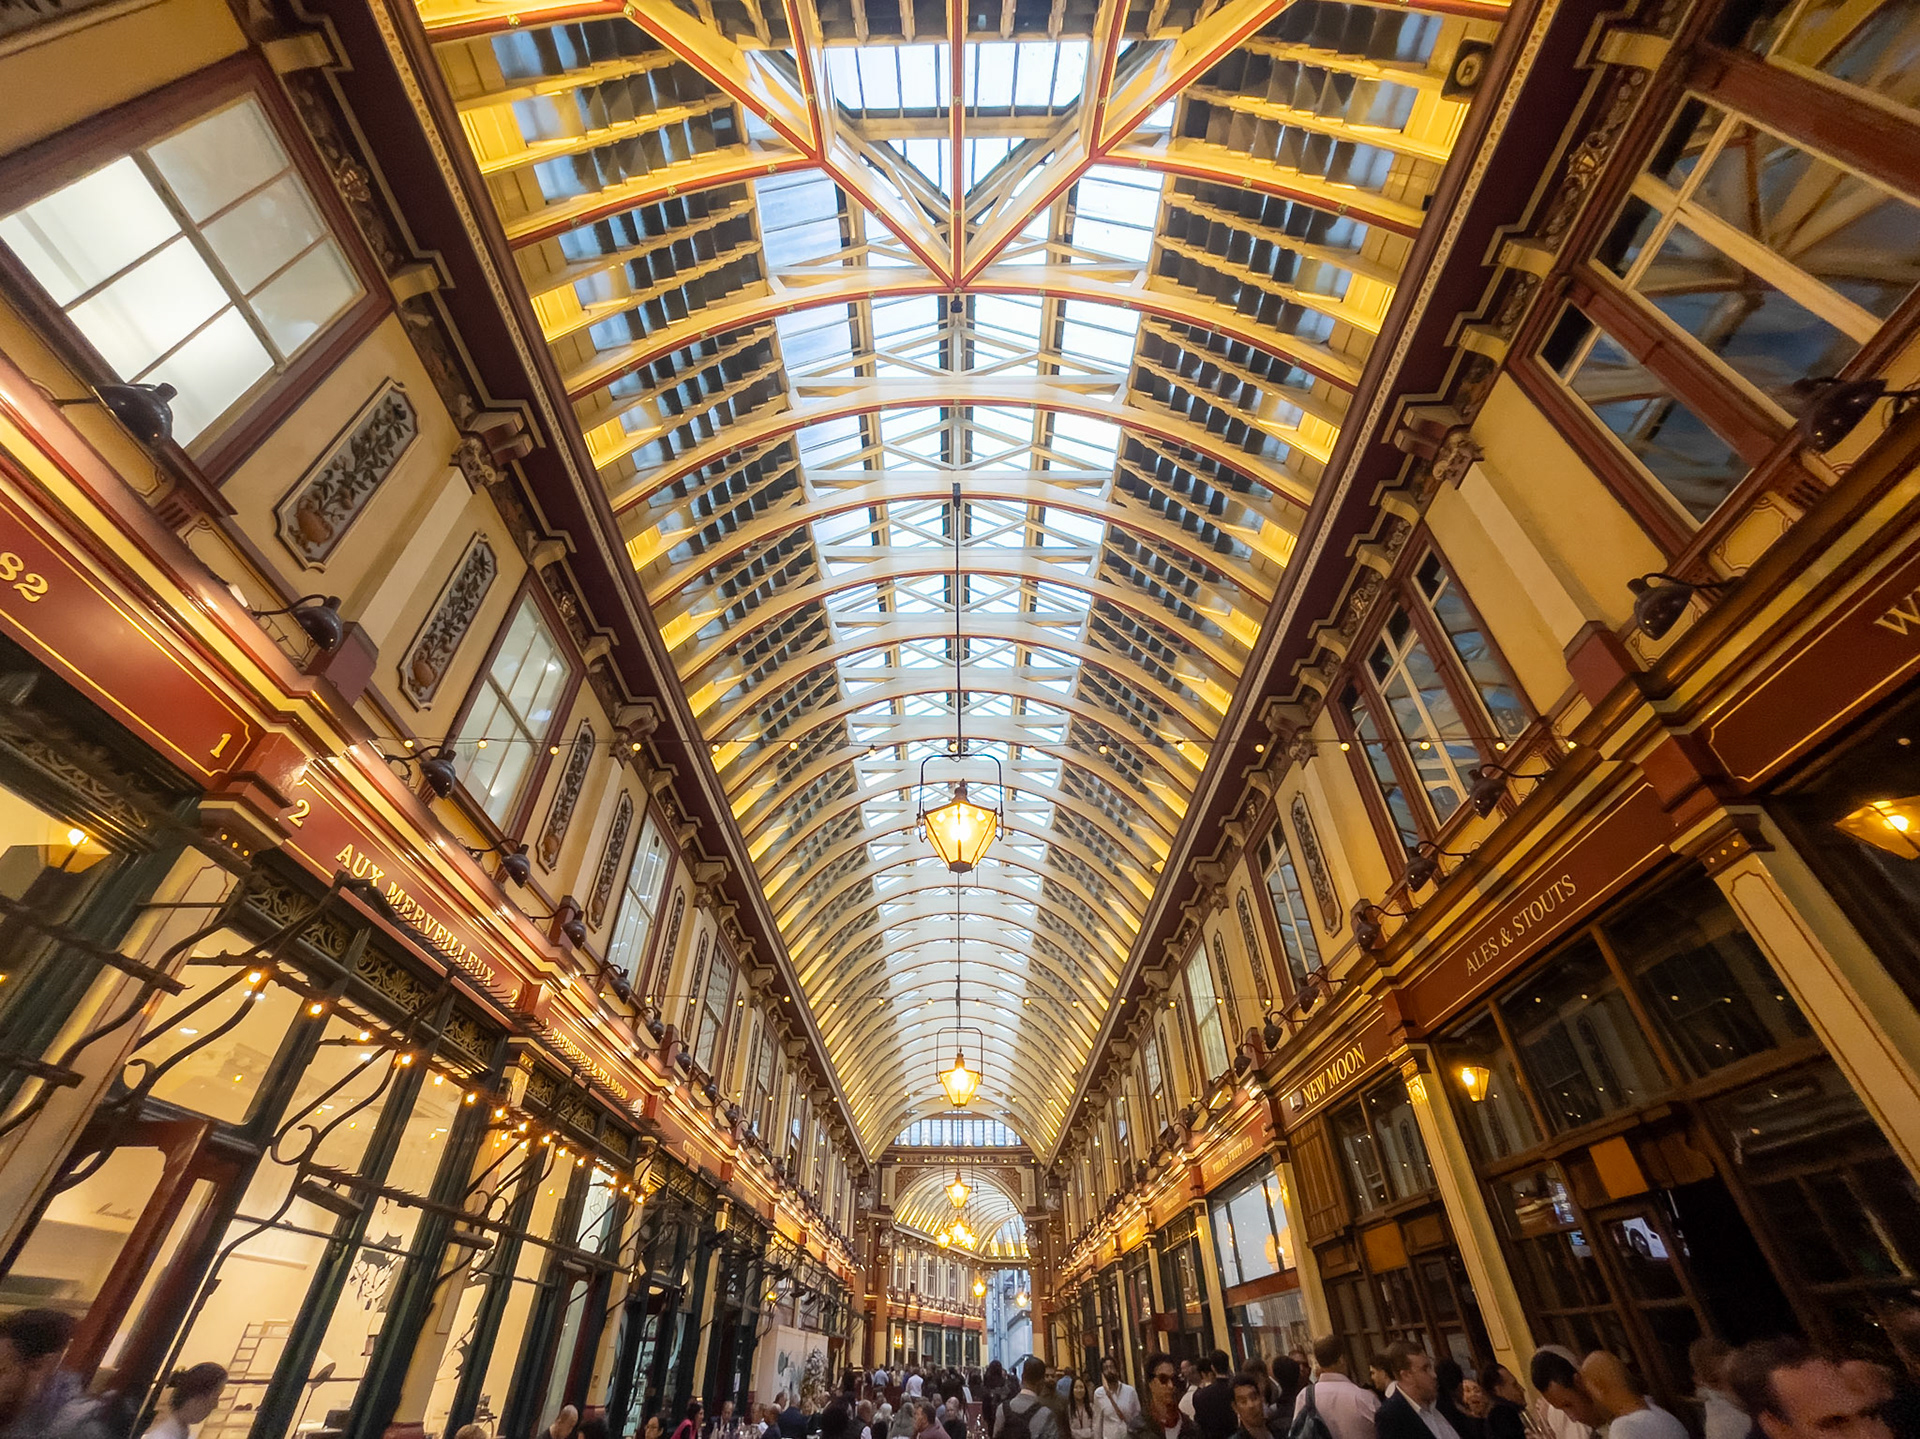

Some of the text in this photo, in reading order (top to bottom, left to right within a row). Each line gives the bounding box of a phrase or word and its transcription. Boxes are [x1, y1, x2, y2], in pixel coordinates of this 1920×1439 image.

[209, 733, 232, 758] 1
[287, 799, 310, 828] 2
[335, 843, 495, 987] AUX MERVEILLEUX
[1465, 874, 1577, 977] ALES & STOUTS
[552, 1027, 593, 1071] PATISSERIE
[1302, 1042, 1367, 1108] NEW MOON
[1242, 1135, 1254, 1151] TEA
